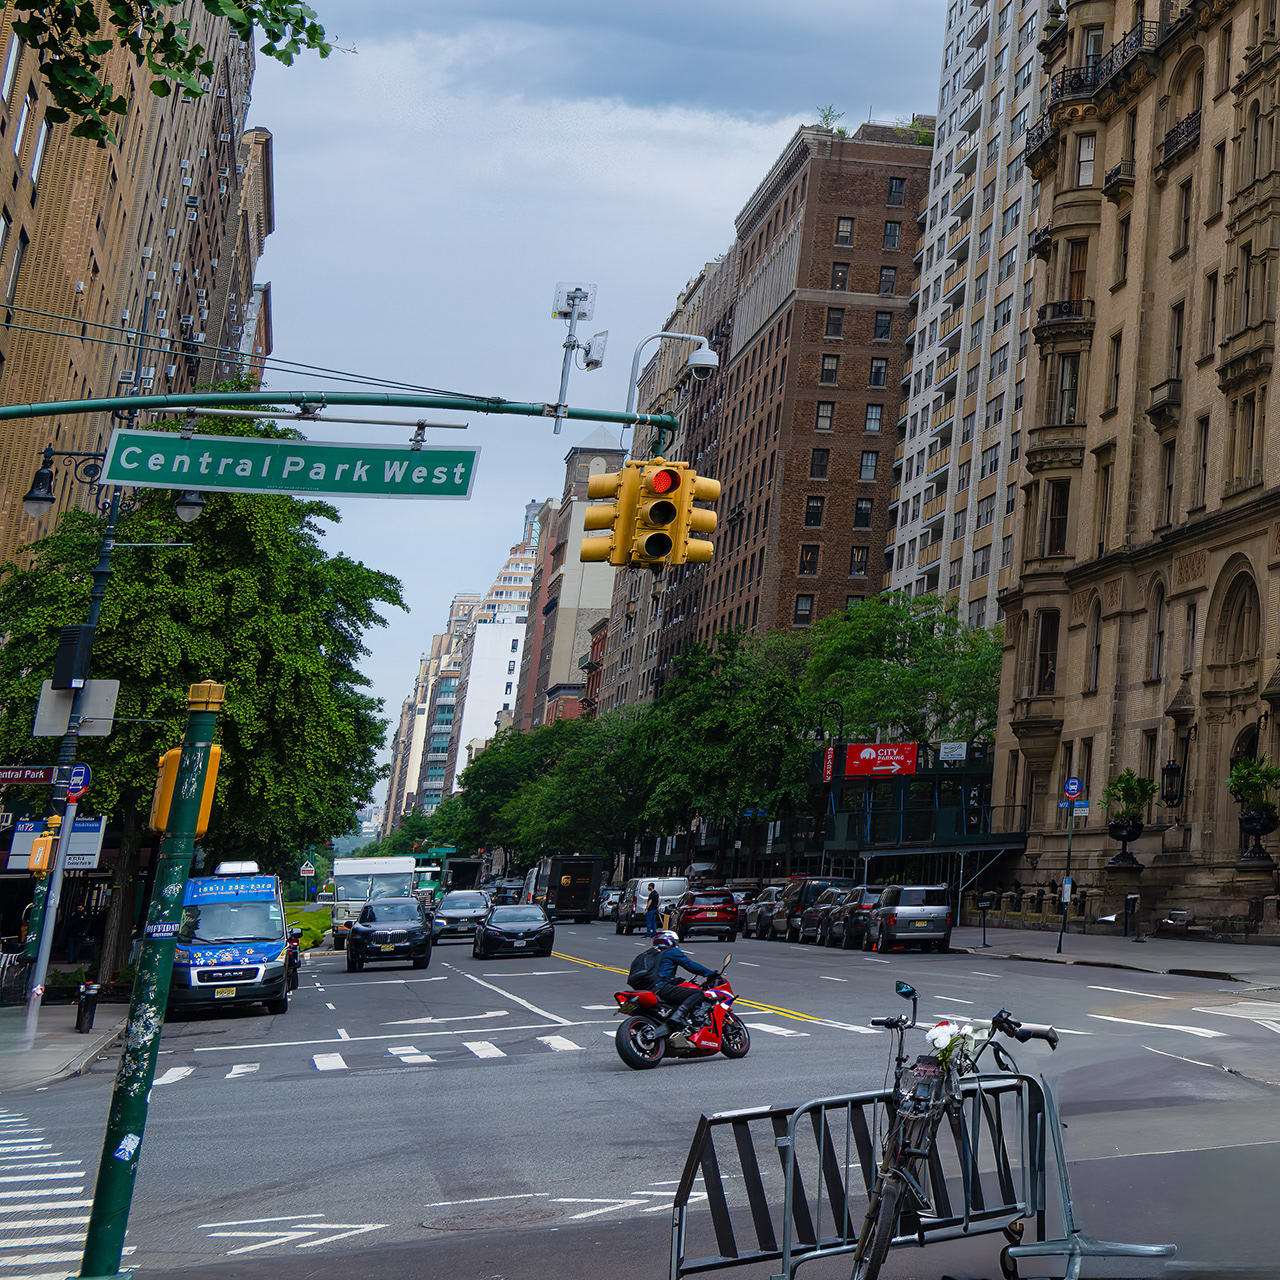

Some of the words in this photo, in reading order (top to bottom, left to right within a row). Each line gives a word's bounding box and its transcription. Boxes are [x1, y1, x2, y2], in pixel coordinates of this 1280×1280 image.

[119, 446, 272, 477] Central
[282, 456, 371, 482] Park
[384, 460, 465, 485] West
[878, 748, 899, 756] CITY
[0, 770, 22, 779] entral
[24, 770, 45, 779] Park
